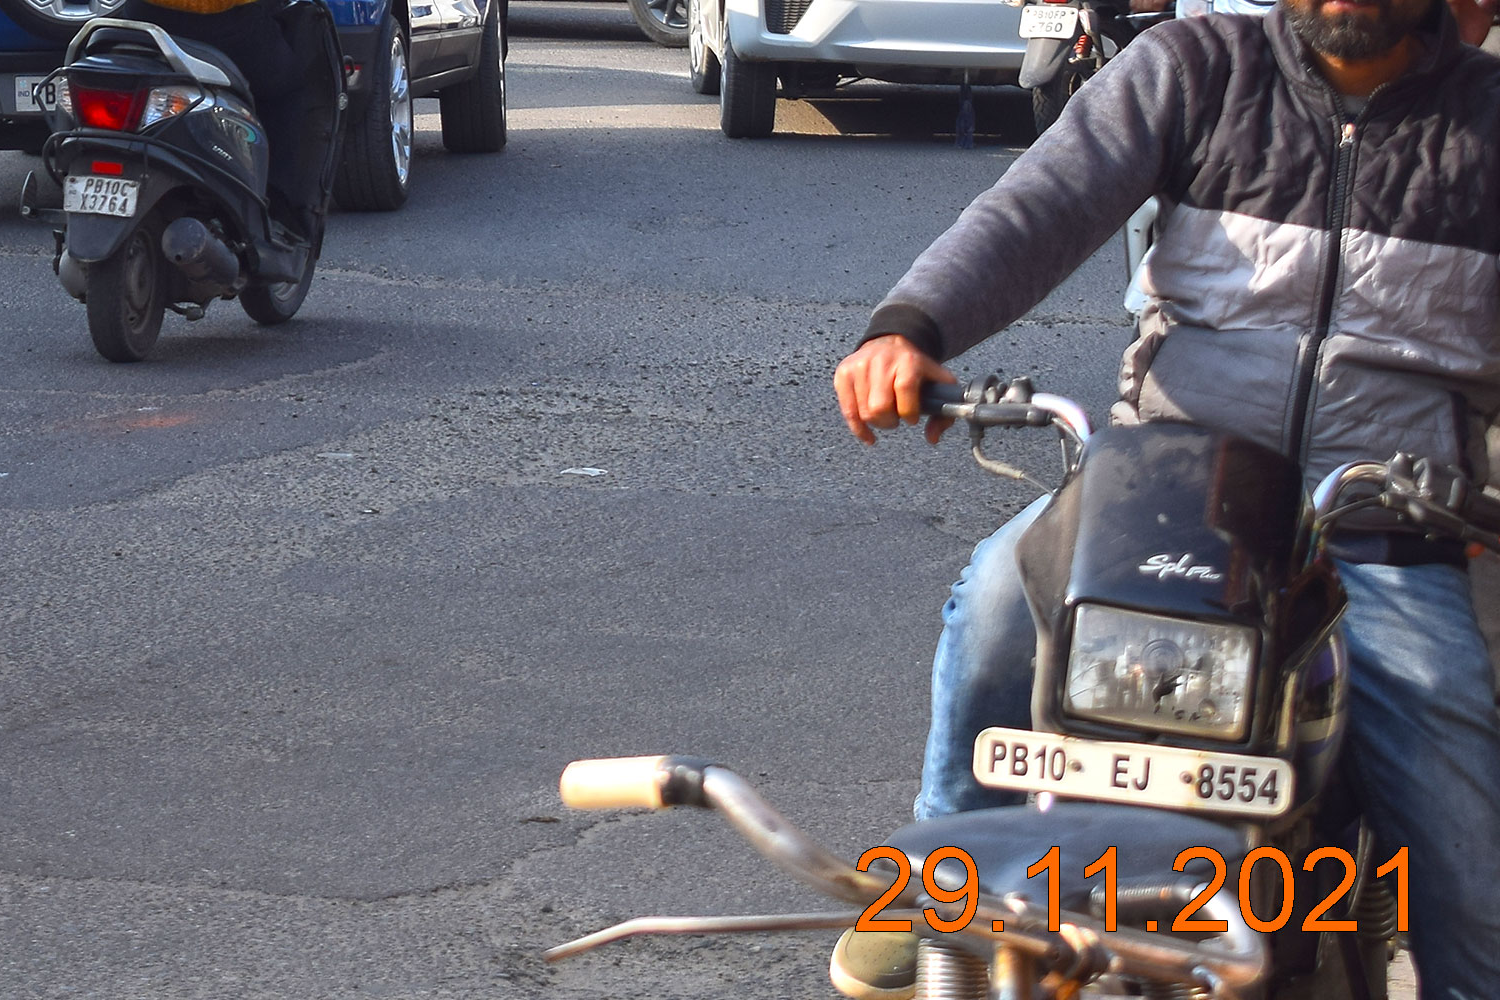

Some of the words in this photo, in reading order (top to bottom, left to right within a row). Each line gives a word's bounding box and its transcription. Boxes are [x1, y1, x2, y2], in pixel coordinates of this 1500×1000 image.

[84, 178, 129, 197] PB10C
[80, 193, 129, 214] X3764
[988, 739, 1067, 782] PB10
[1109, 753, 1151, 791] EJ
[1196, 763, 1279, 806] 8554
